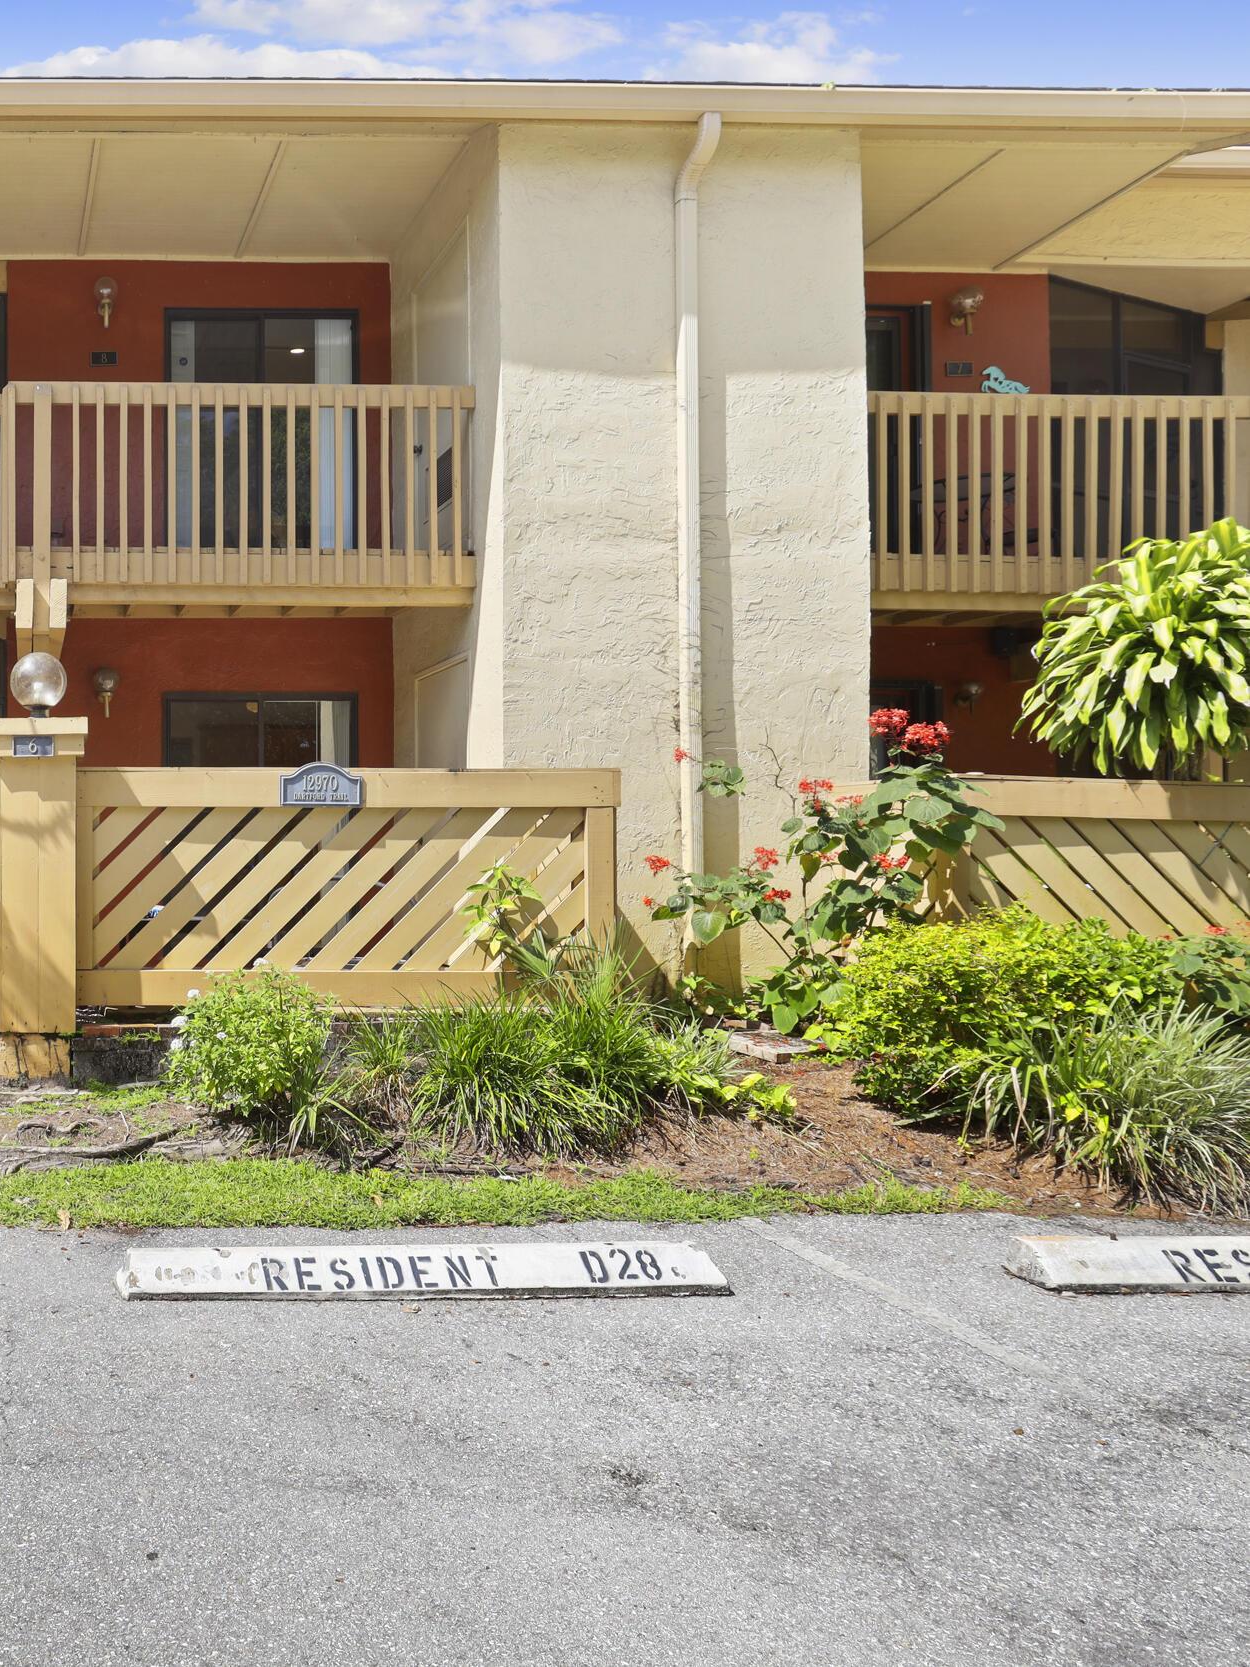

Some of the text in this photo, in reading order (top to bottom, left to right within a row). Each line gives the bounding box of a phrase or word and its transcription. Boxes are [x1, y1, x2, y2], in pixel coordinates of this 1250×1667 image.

[29, 738, 38, 753] 6
[303, 774, 338, 791] 12970
[293, 792, 349, 801] DARTFORD TRAIL
[261, 1248, 663, 1291] RESIDENT D28
